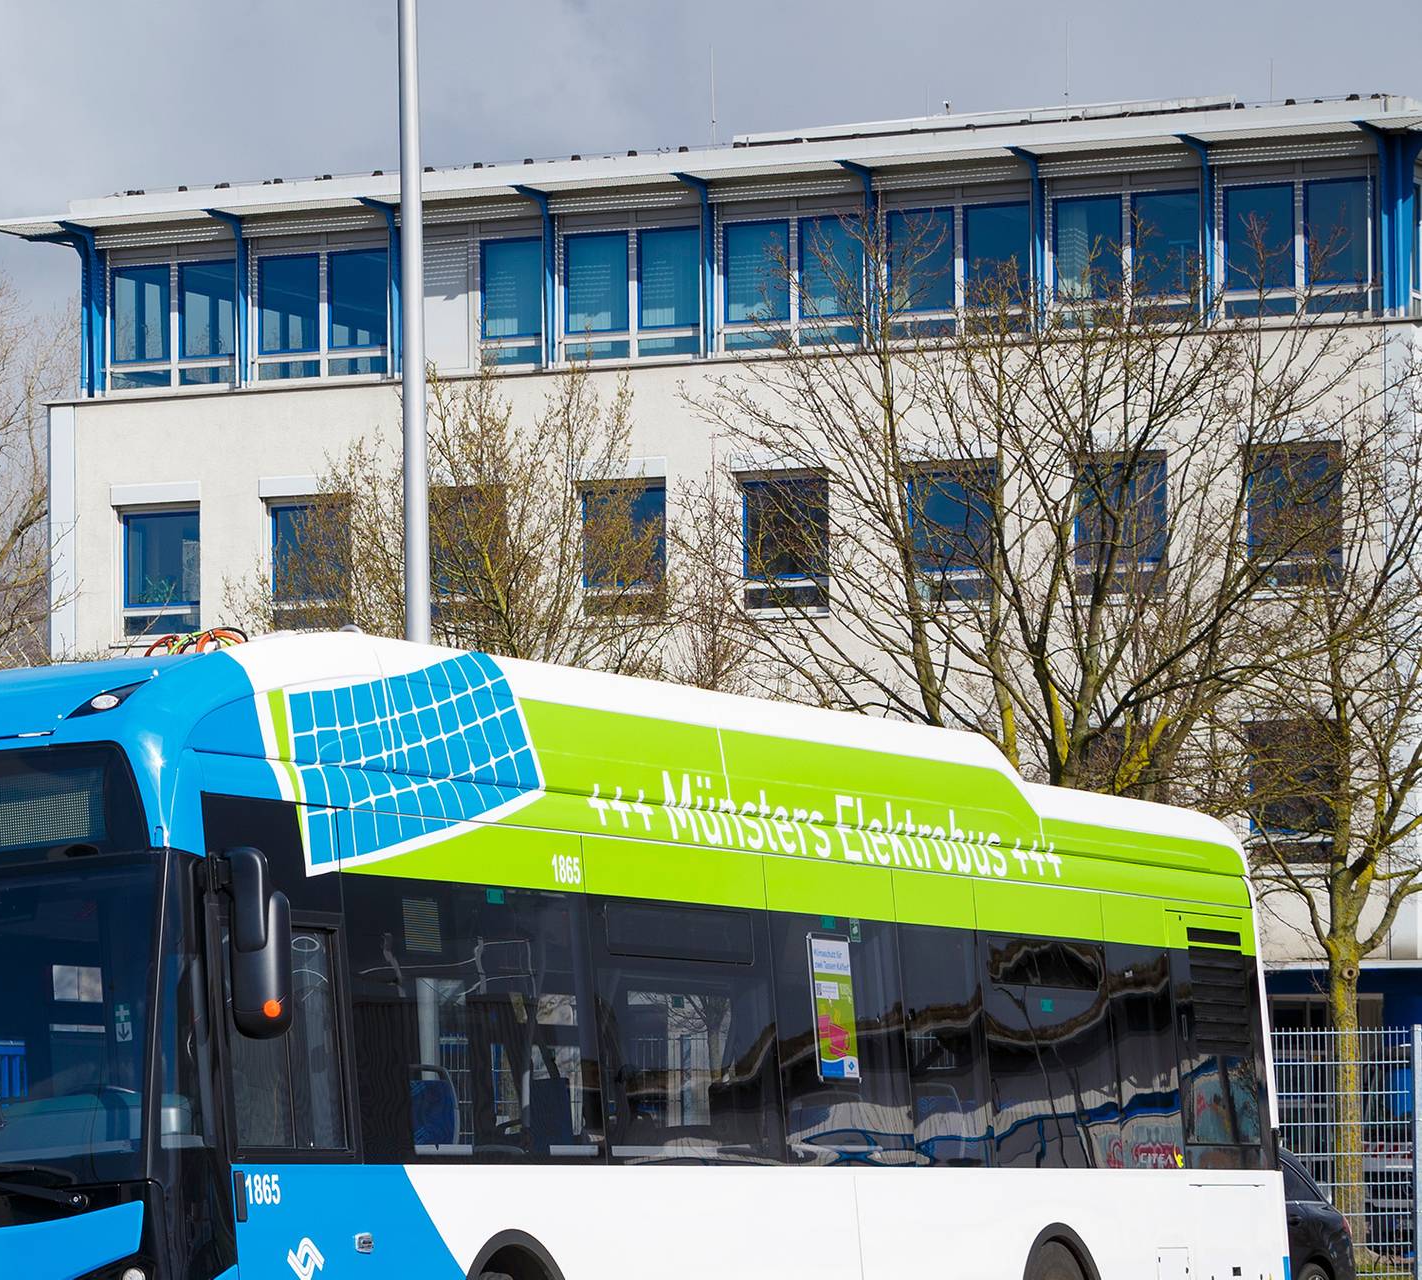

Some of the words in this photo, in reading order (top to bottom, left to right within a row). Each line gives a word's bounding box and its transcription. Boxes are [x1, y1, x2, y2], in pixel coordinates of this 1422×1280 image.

[661, 770, 832, 859] Münsters
[834, 794, 1008, 878] Elektrobus
[551, 854, 581, 885] 1865
[245, 1173, 281, 1205] 1865
